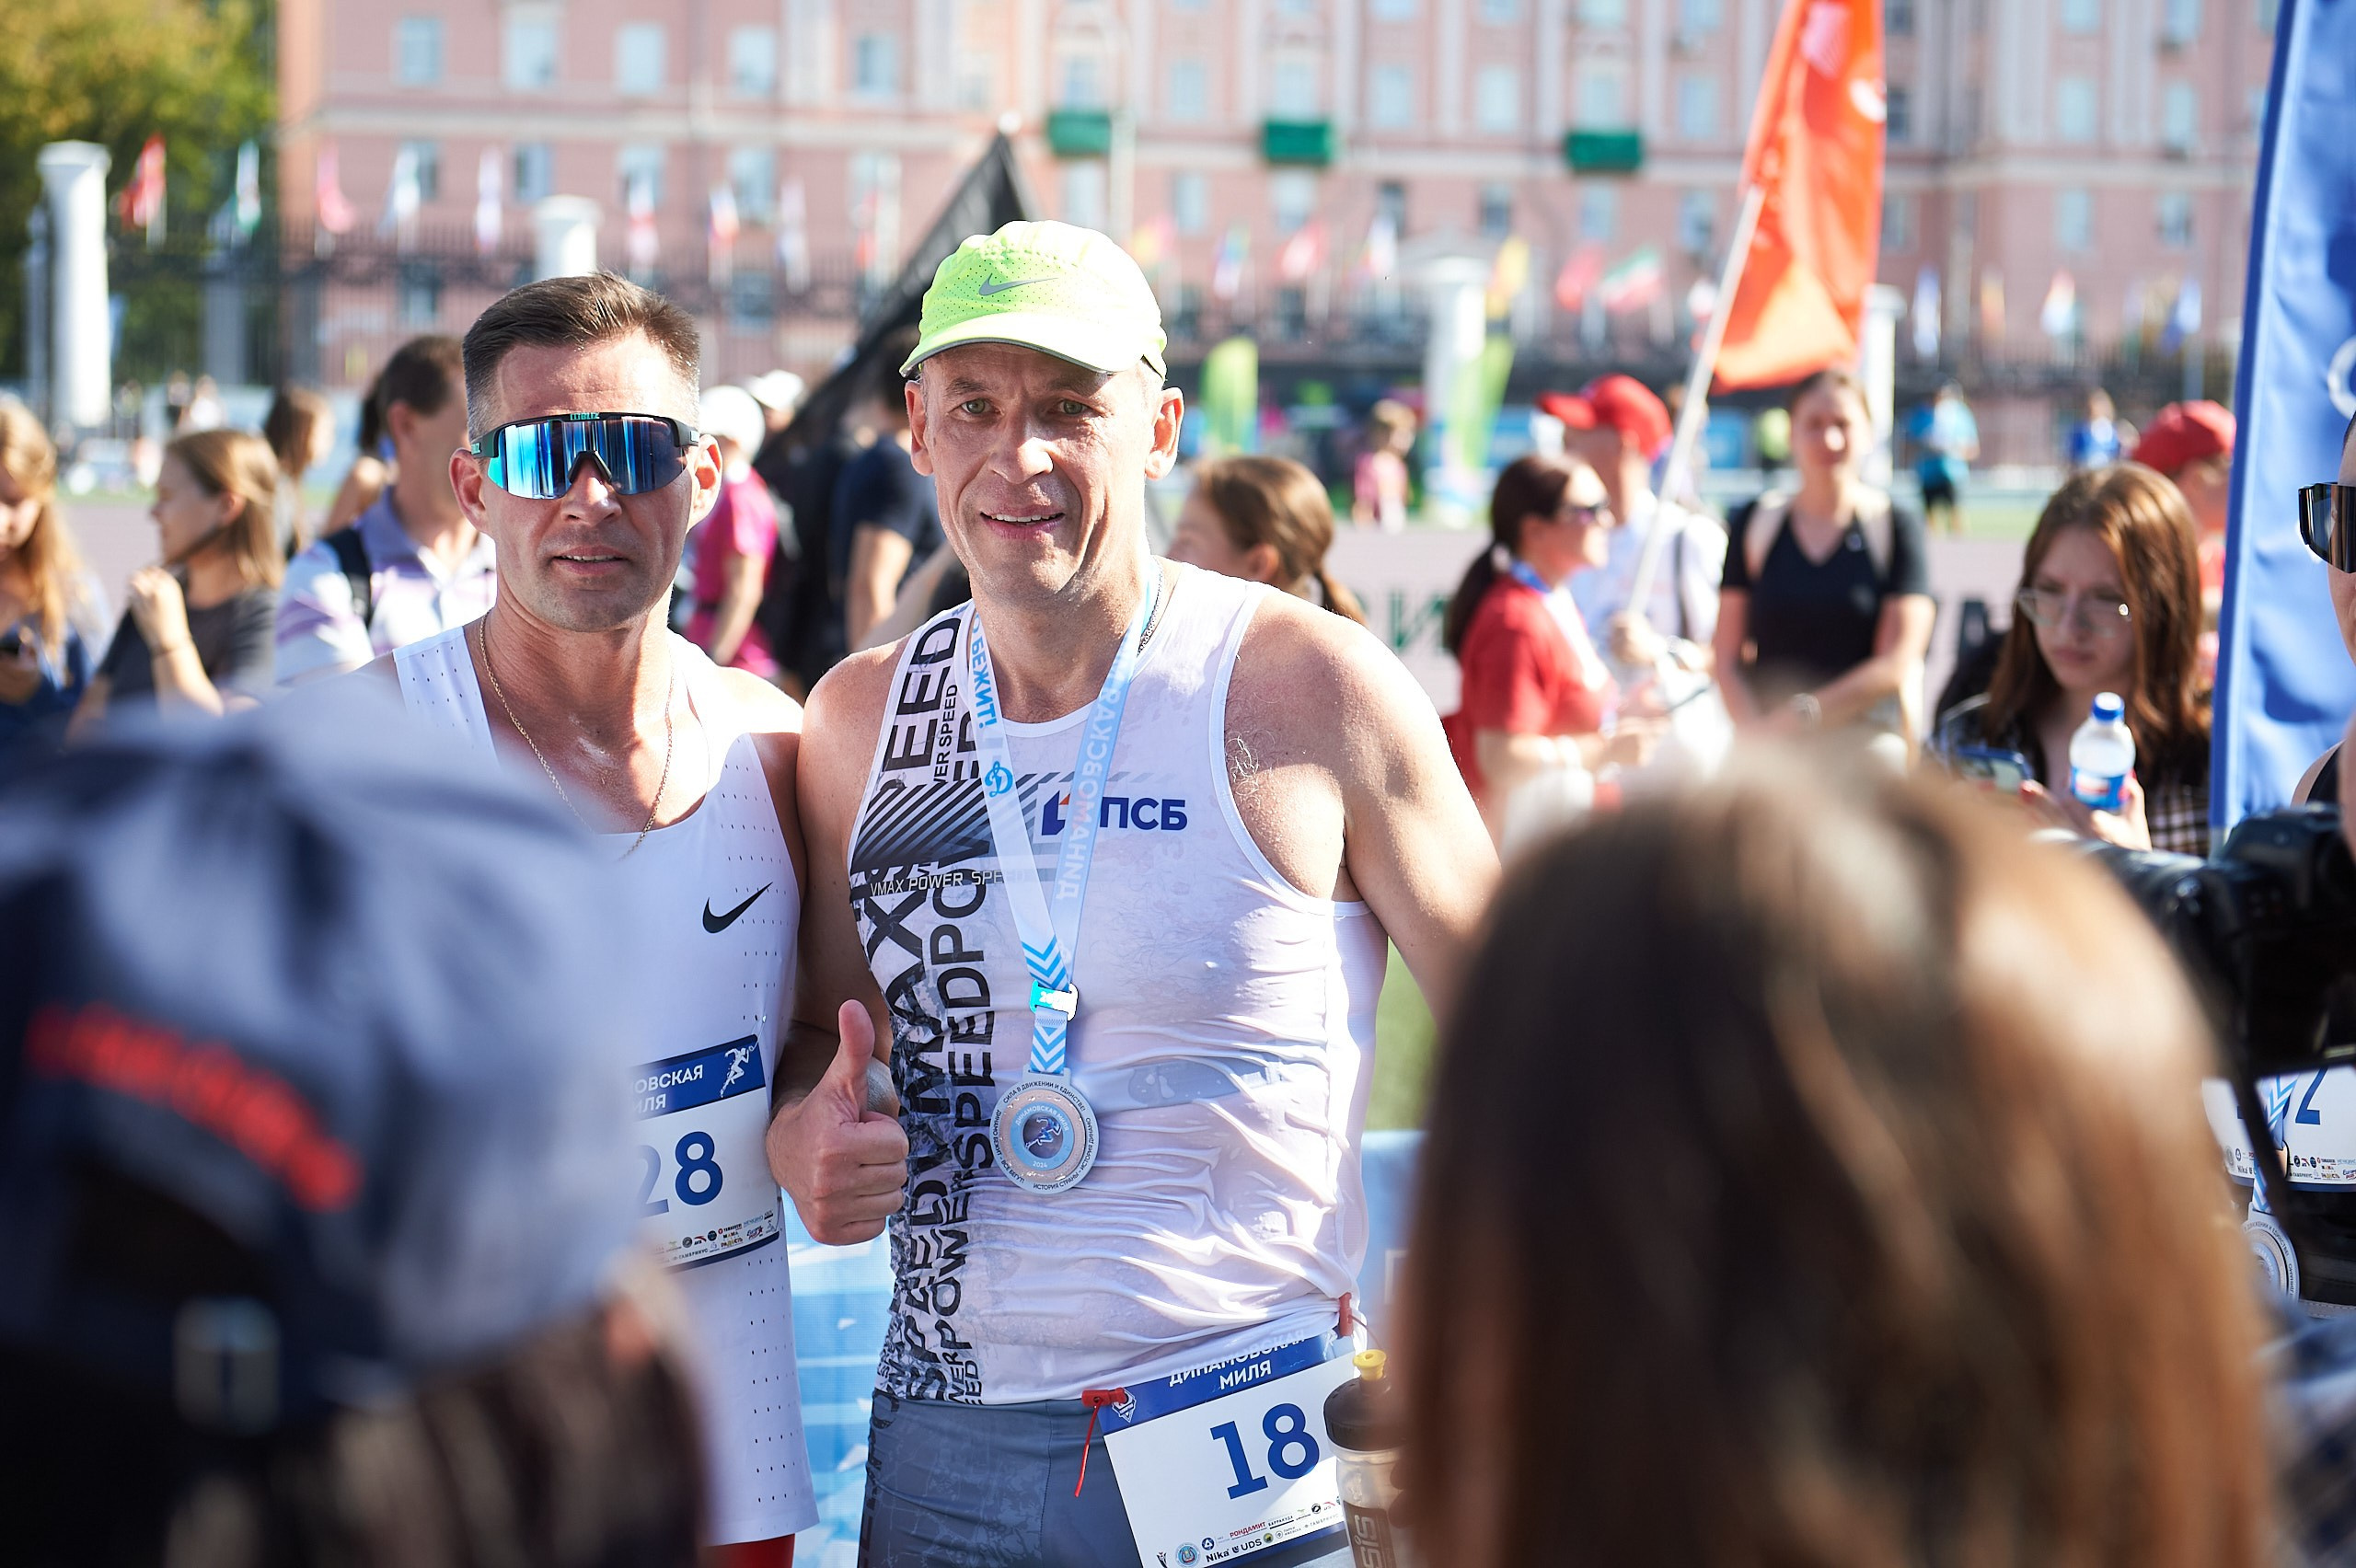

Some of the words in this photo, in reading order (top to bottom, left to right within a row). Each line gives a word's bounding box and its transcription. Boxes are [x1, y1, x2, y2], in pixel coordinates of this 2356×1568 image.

[971, 637, 999, 729] БЕЖИТ!
[939, 685, 958, 747] SPEED
[1100, 797, 1188, 831] ПСБ
[871, 880, 904, 897] VMAX
[907, 872, 964, 892] POWER
[633, 1064, 704, 1094] ОВСКАЯ
[1003, 1090, 1017, 1104] СИЛА
[1022, 1080, 1054, 1090] ДВИЖЕНИИ
[632, 1093, 666, 1114] ИЛЯ
[635, 1131, 723, 1218] 28
[1218, 1360, 1272, 1390] МИЛЯ
[1210, 1402, 1321, 1500] 18
[1230, 1521, 1266, 1539] РОНДАМИТ
[1206, 1548, 1229, 1562] Nika
[1241, 1539, 1262, 1552] UDS
